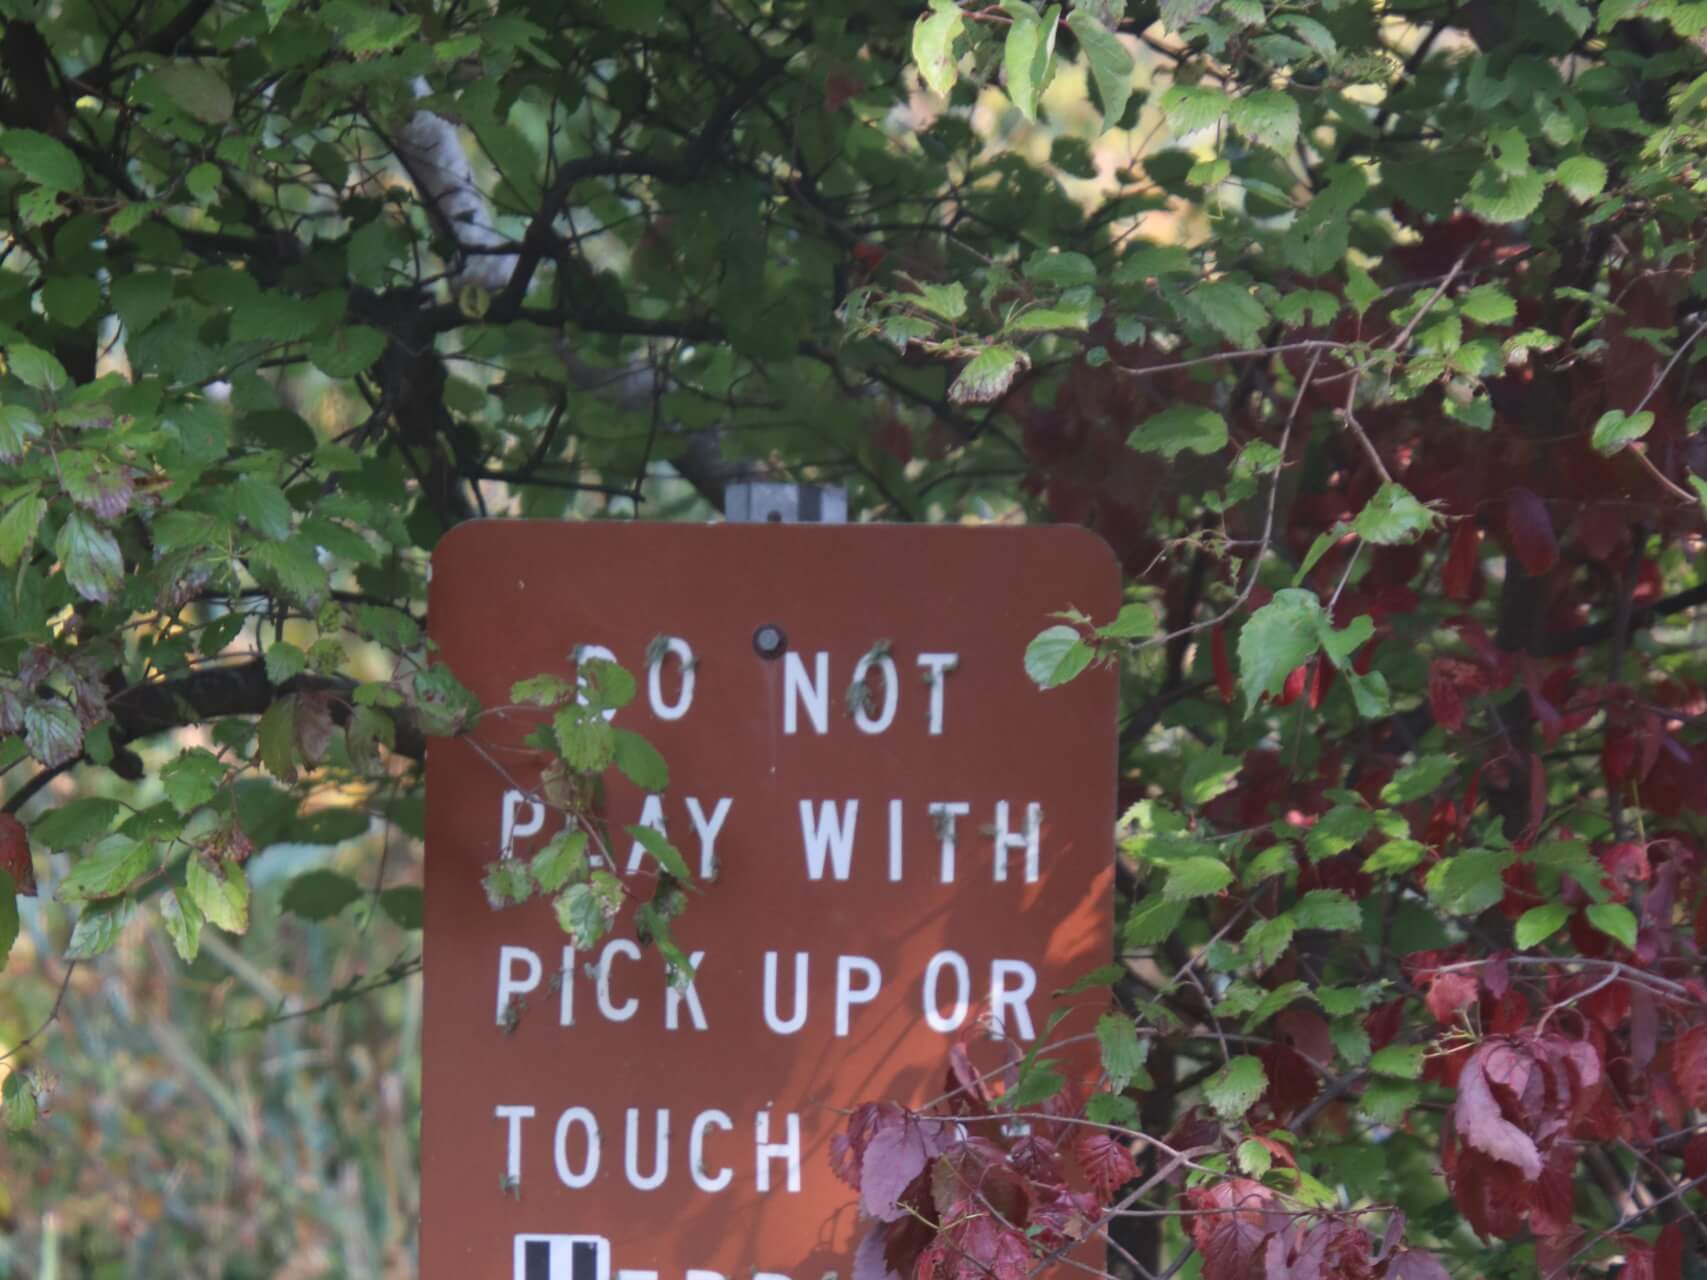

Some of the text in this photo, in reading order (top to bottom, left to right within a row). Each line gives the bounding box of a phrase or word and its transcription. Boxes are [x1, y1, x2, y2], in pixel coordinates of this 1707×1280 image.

[783, 645, 957, 735] NOT
[500, 789, 1041, 884] PAY WITH
[496, 938, 1036, 1042] PICK UP OR
[496, 1105, 801, 1193] TOUCH
